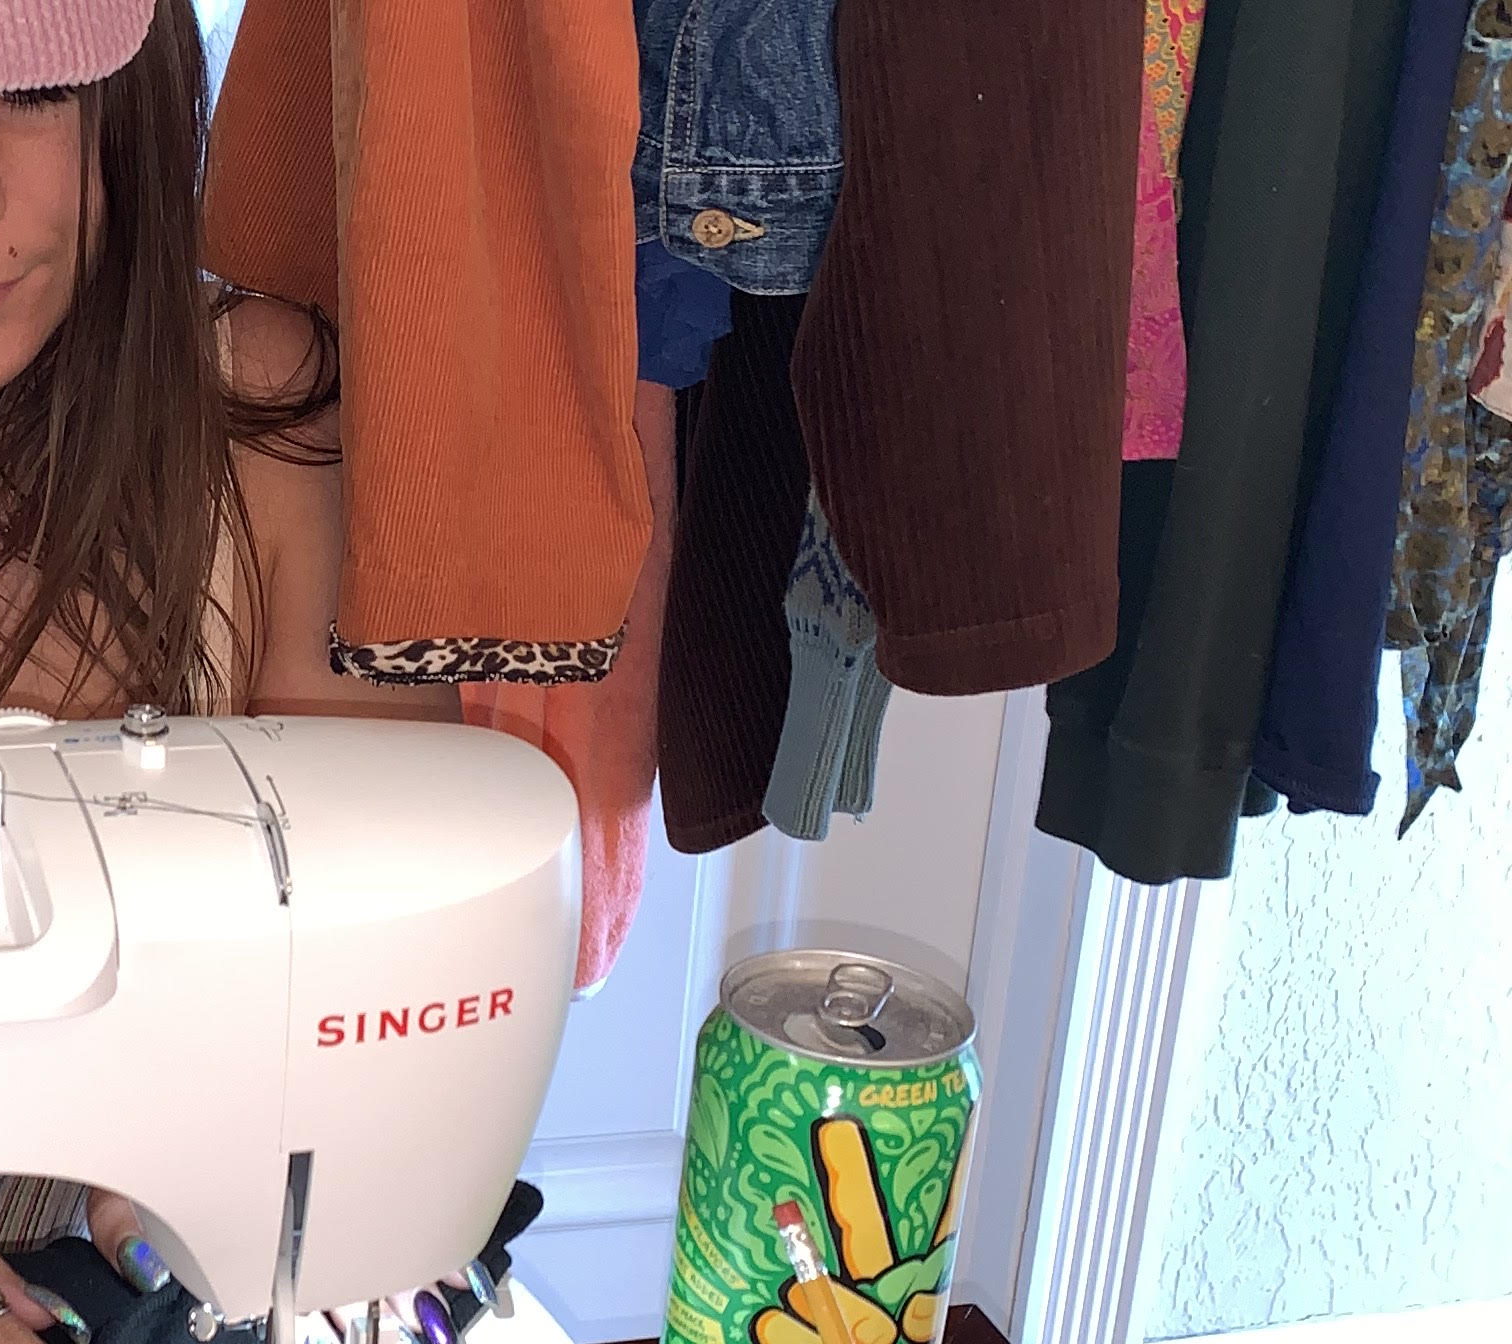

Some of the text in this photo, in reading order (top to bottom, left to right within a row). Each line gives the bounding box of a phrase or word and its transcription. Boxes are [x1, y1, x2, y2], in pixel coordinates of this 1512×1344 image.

[316, 987, 515, 1048] SINGER
[858, 1068, 967, 1109] GREEN TE
